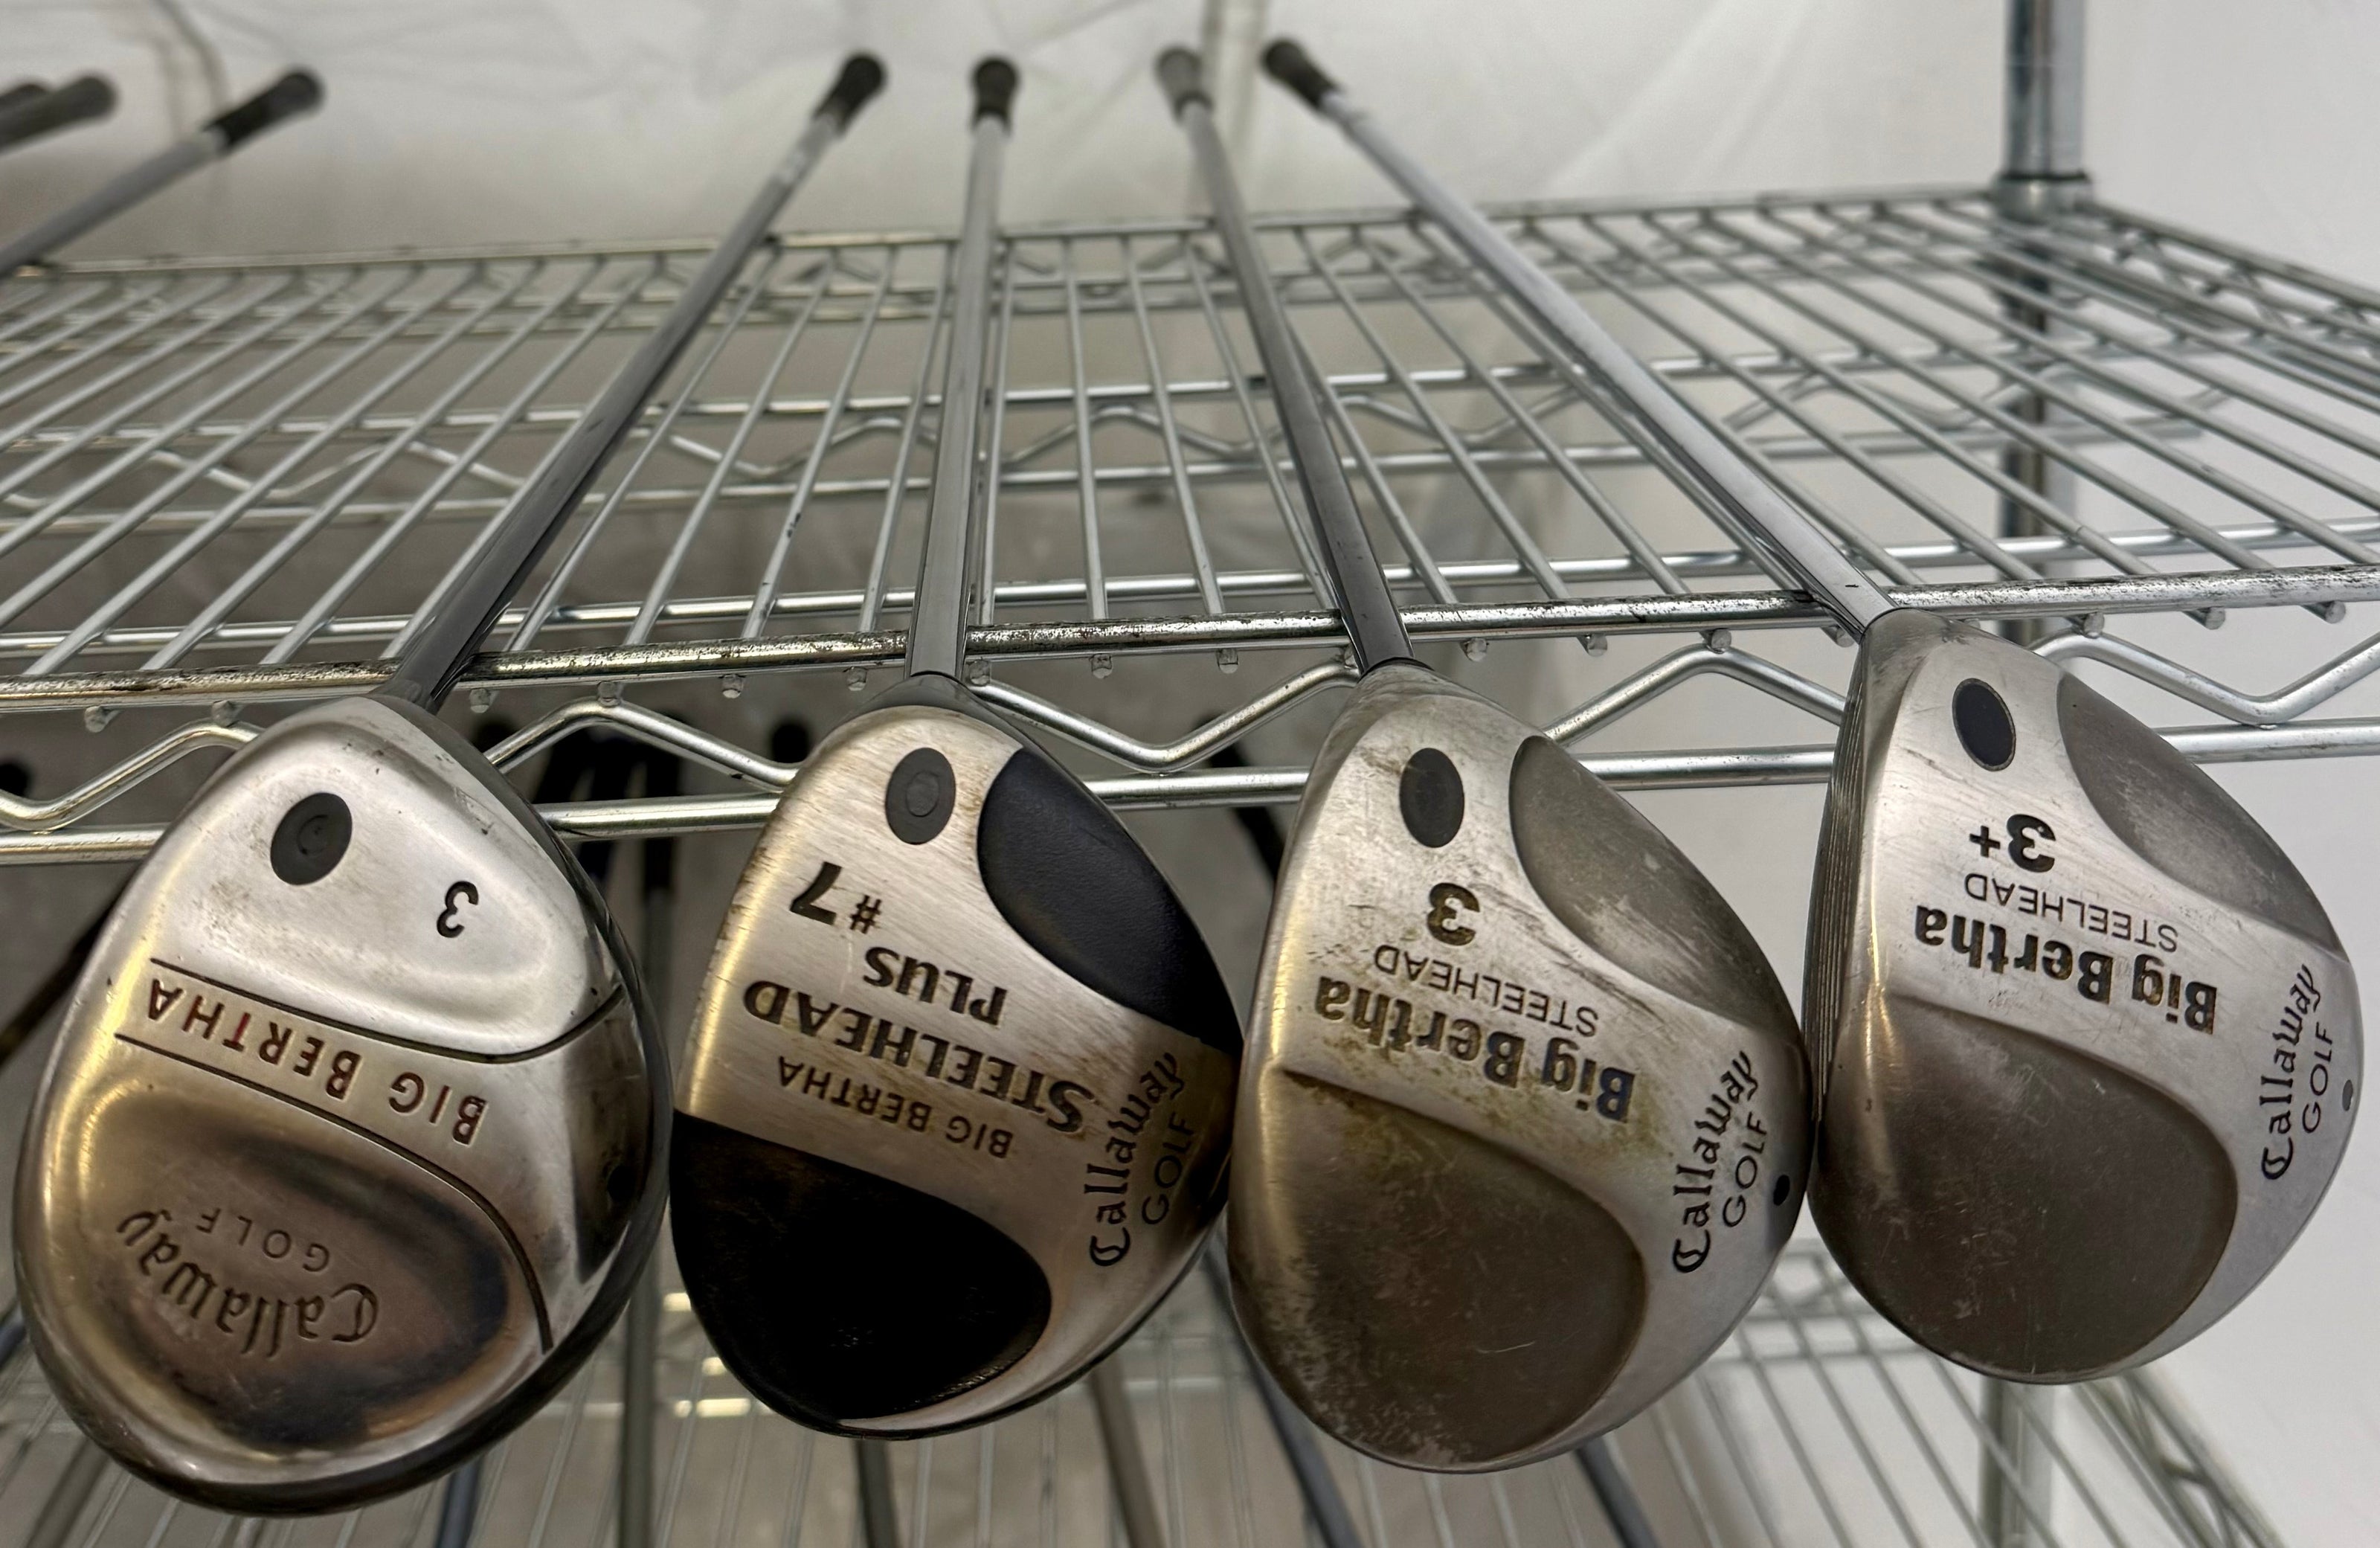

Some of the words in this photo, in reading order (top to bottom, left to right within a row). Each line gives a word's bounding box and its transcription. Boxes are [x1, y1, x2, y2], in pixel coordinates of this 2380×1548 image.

[437, 880, 479, 938] 3
[789, 861, 884, 934] #7
[1427, 881, 1482, 947] 3
[1964, 872, 2179, 953] STEELHEAD
[863, 947, 1007, 1026] PLUS
[1375, 943, 1598, 1038] STEELHEAD
[1914, 905, 2114, 1004] Bertha
[2132, 954, 2218, 1036] Big
[149, 978, 362, 1100] BERTHA
[743, 980, 1094, 1134] STEELHEAD
[1314, 975, 1526, 1090] Bertha
[2258, 964, 2321, 1181] Callaway
[2302, 1022, 2335, 1134] GOLF
[387, 1071, 489, 1146] BIG
[778, 1056, 933, 1134] BERTHA
[1542, 1037, 1636, 1124] Big
[945, 1115, 1014, 1160] BIG
[1084, 1052, 1186, 1267] Callaway
[1141, 1111, 1195, 1226] GOLF
[1672, 1050, 1760, 1274] Callaway
[1722, 1112, 1769, 1228] GOLF
[117, 1209, 379, 1358] Callaway
[196, 1206, 330, 1271] GOLF
